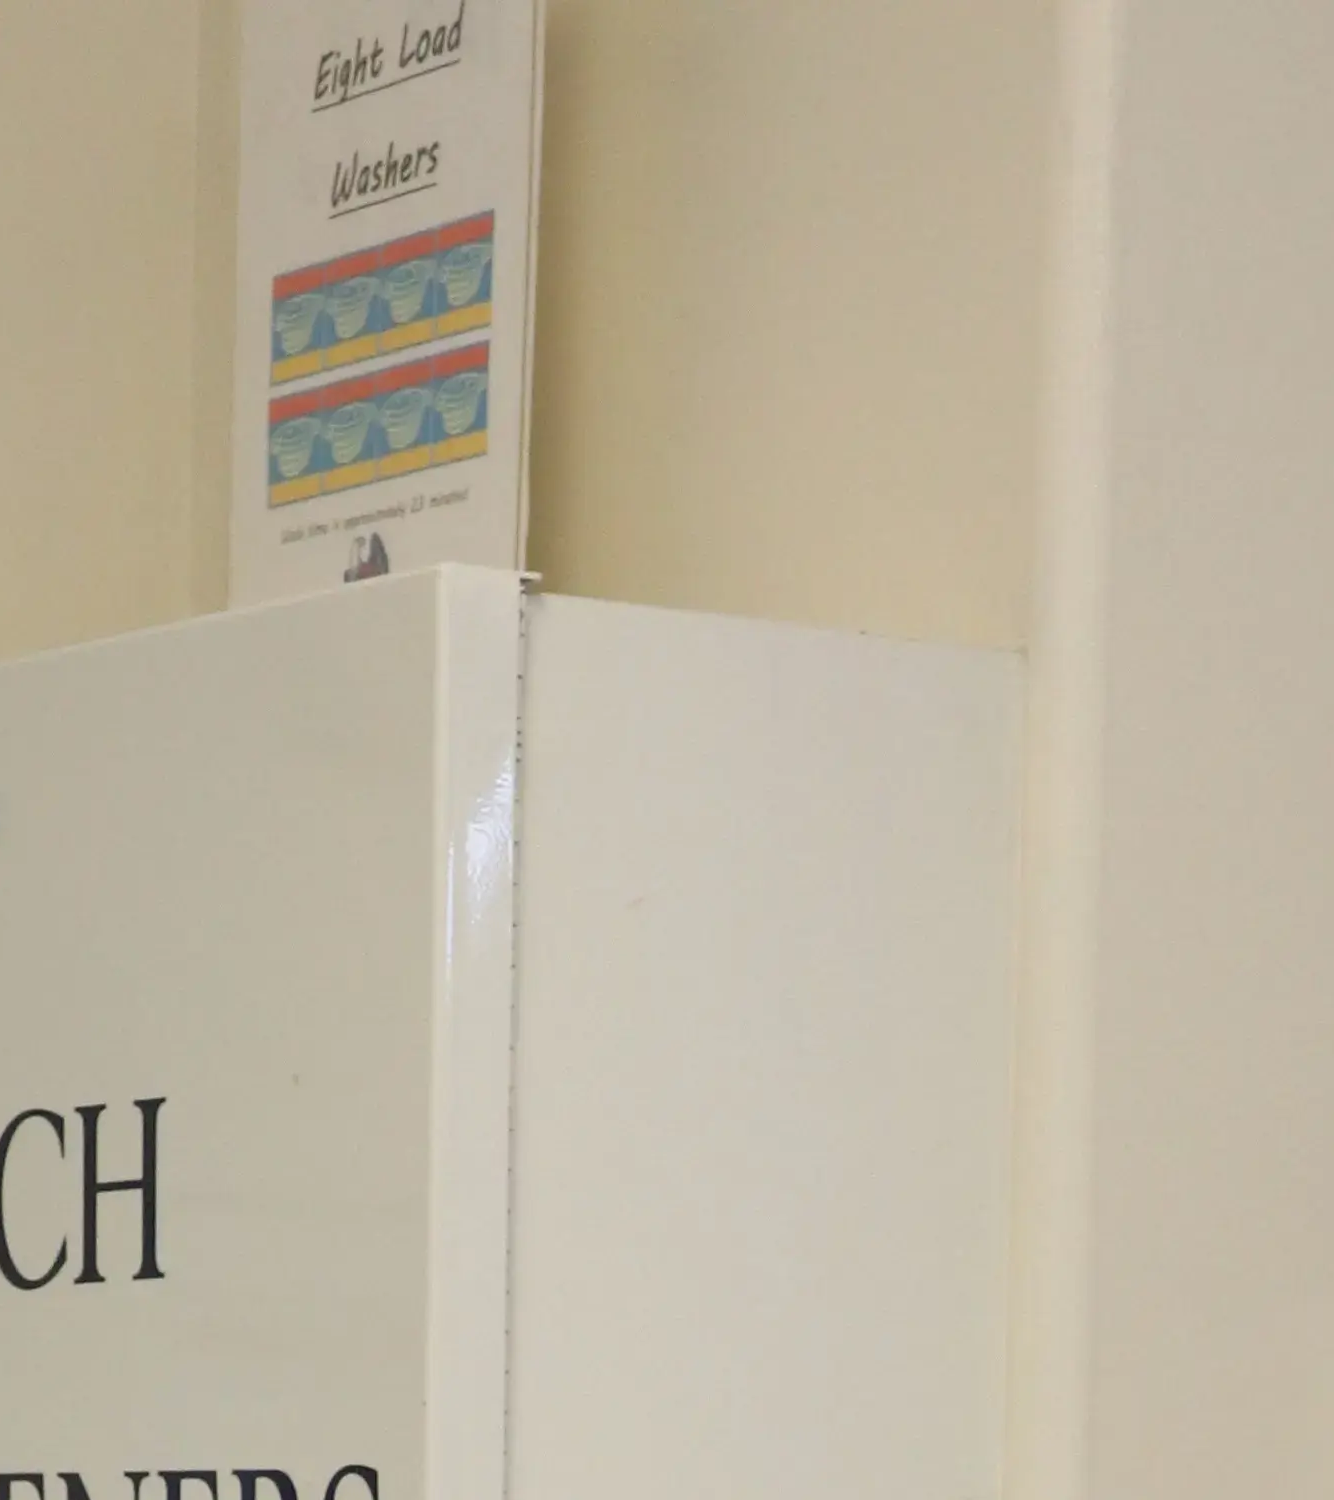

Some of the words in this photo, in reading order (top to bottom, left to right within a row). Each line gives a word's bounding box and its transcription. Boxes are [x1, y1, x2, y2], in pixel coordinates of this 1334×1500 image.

[314, 38, 384, 102] Eight
[399, 0, 465, 69] Load
[331, 140, 440, 208] Washers
